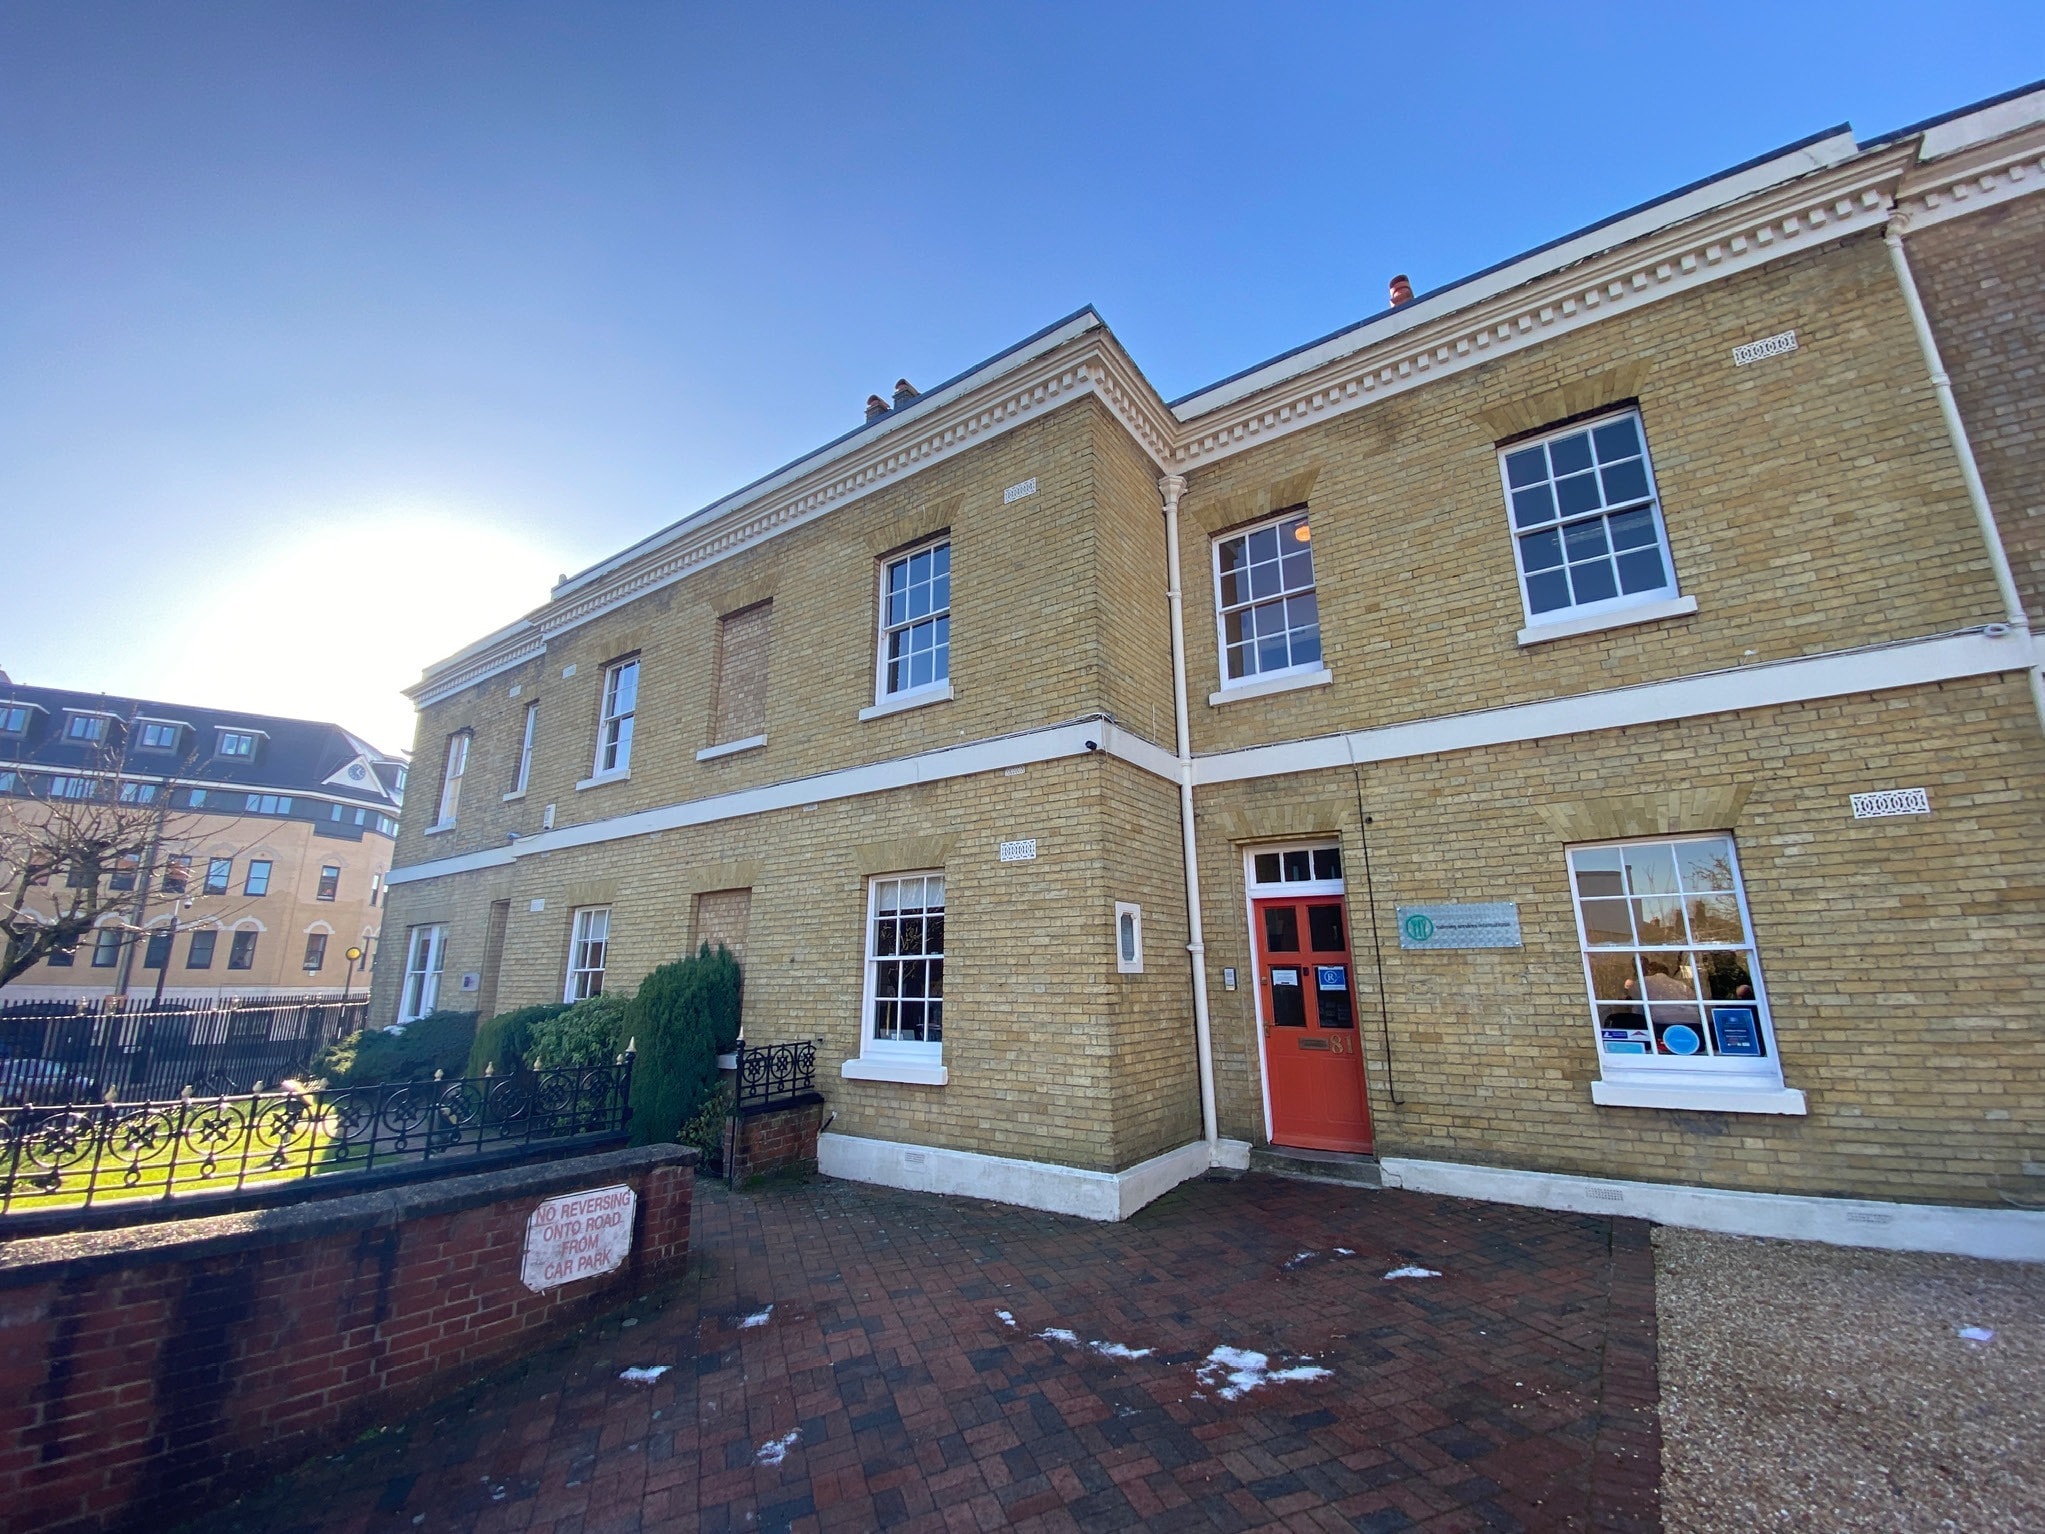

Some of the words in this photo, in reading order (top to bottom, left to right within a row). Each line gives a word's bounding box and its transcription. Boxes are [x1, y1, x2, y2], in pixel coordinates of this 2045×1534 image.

[1331, 1035, 1353, 1054] 81
[536, 1206, 556, 1224] NO
[561, 1191, 631, 1219] REVERSING
[543, 1221, 580, 1242] ONTO
[586, 1212, 621, 1233] ROAD
[561, 1234, 599, 1256] FROM
[544, 1259, 573, 1280] CAR
[577, 1249, 612, 1272] PARK
